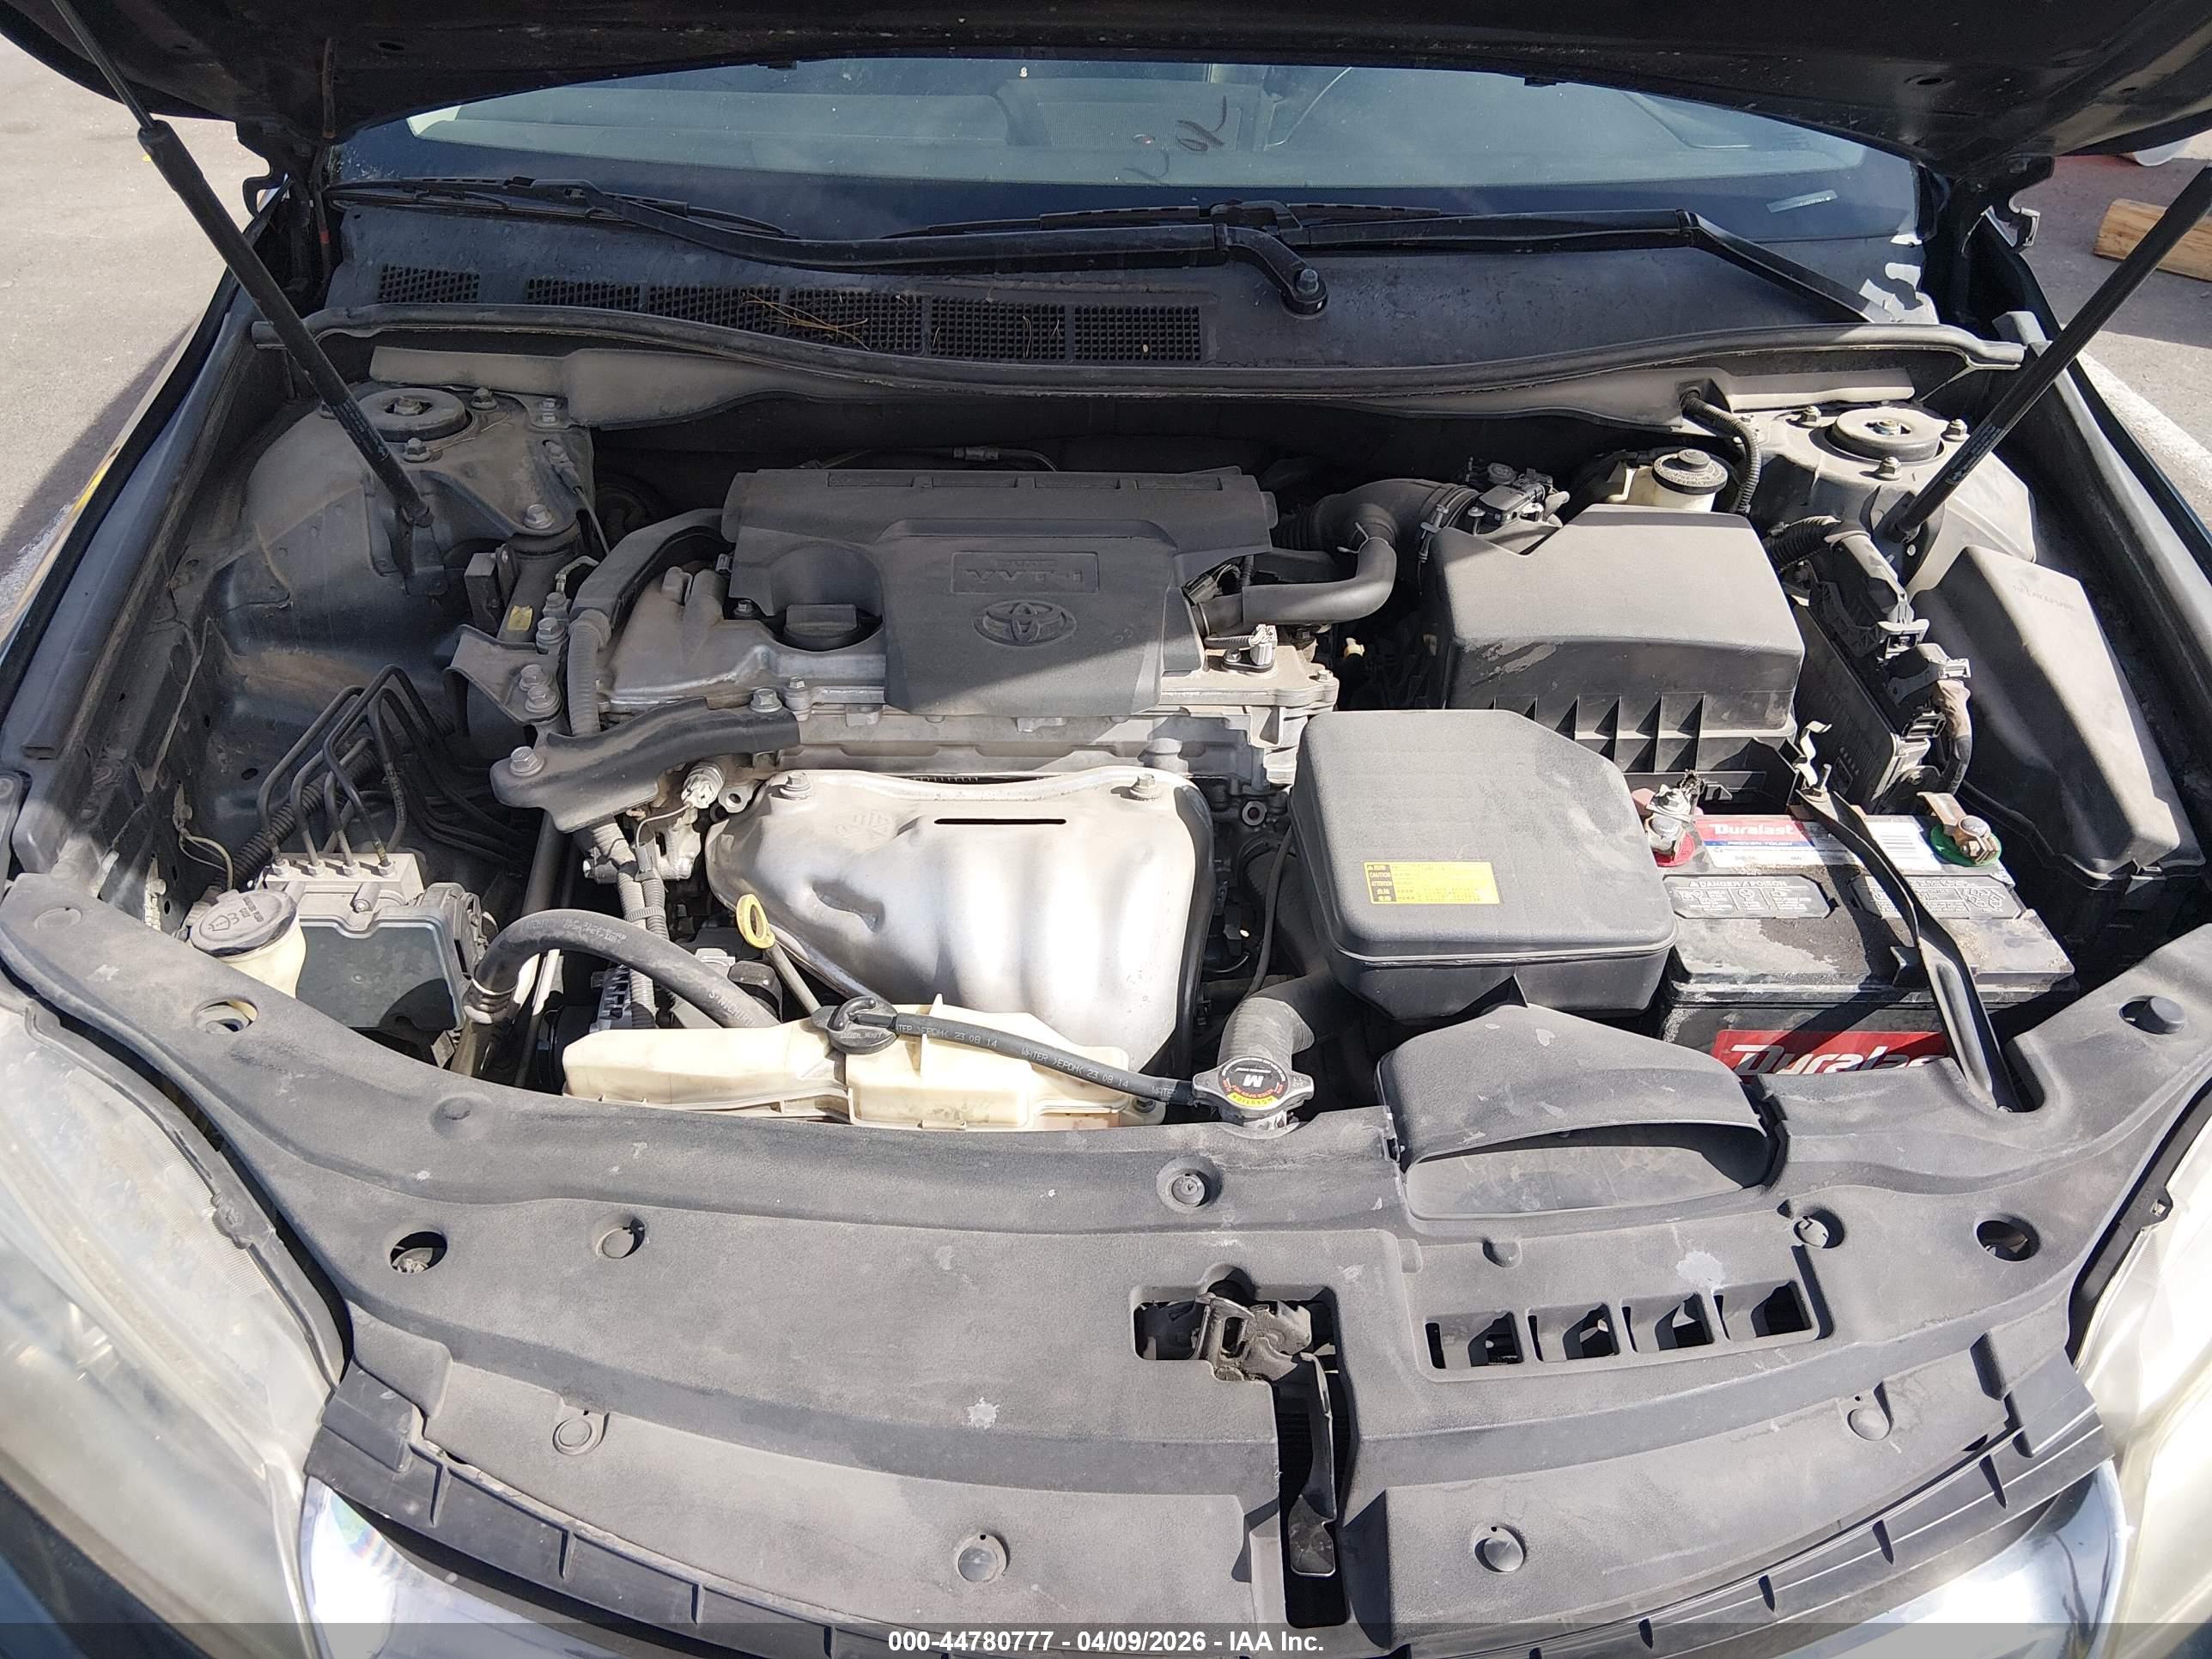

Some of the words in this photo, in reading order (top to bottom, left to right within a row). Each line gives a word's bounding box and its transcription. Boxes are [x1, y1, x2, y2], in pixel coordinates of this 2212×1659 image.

[1709, 823, 1795, 836] Duralast
[953, 1031, 965, 1042] 23
[969, 1036, 981, 1045] 08
[987, 1038, 998, 1048] 14
[1021, 1047, 1048, 1062] WATER
[1086, 1068, 1099, 1079] 23
[1103, 1073, 1114, 1085] 08
[1118, 1079, 1129, 1088] 14
[1730, 1043, 1946, 1074] Duralas
